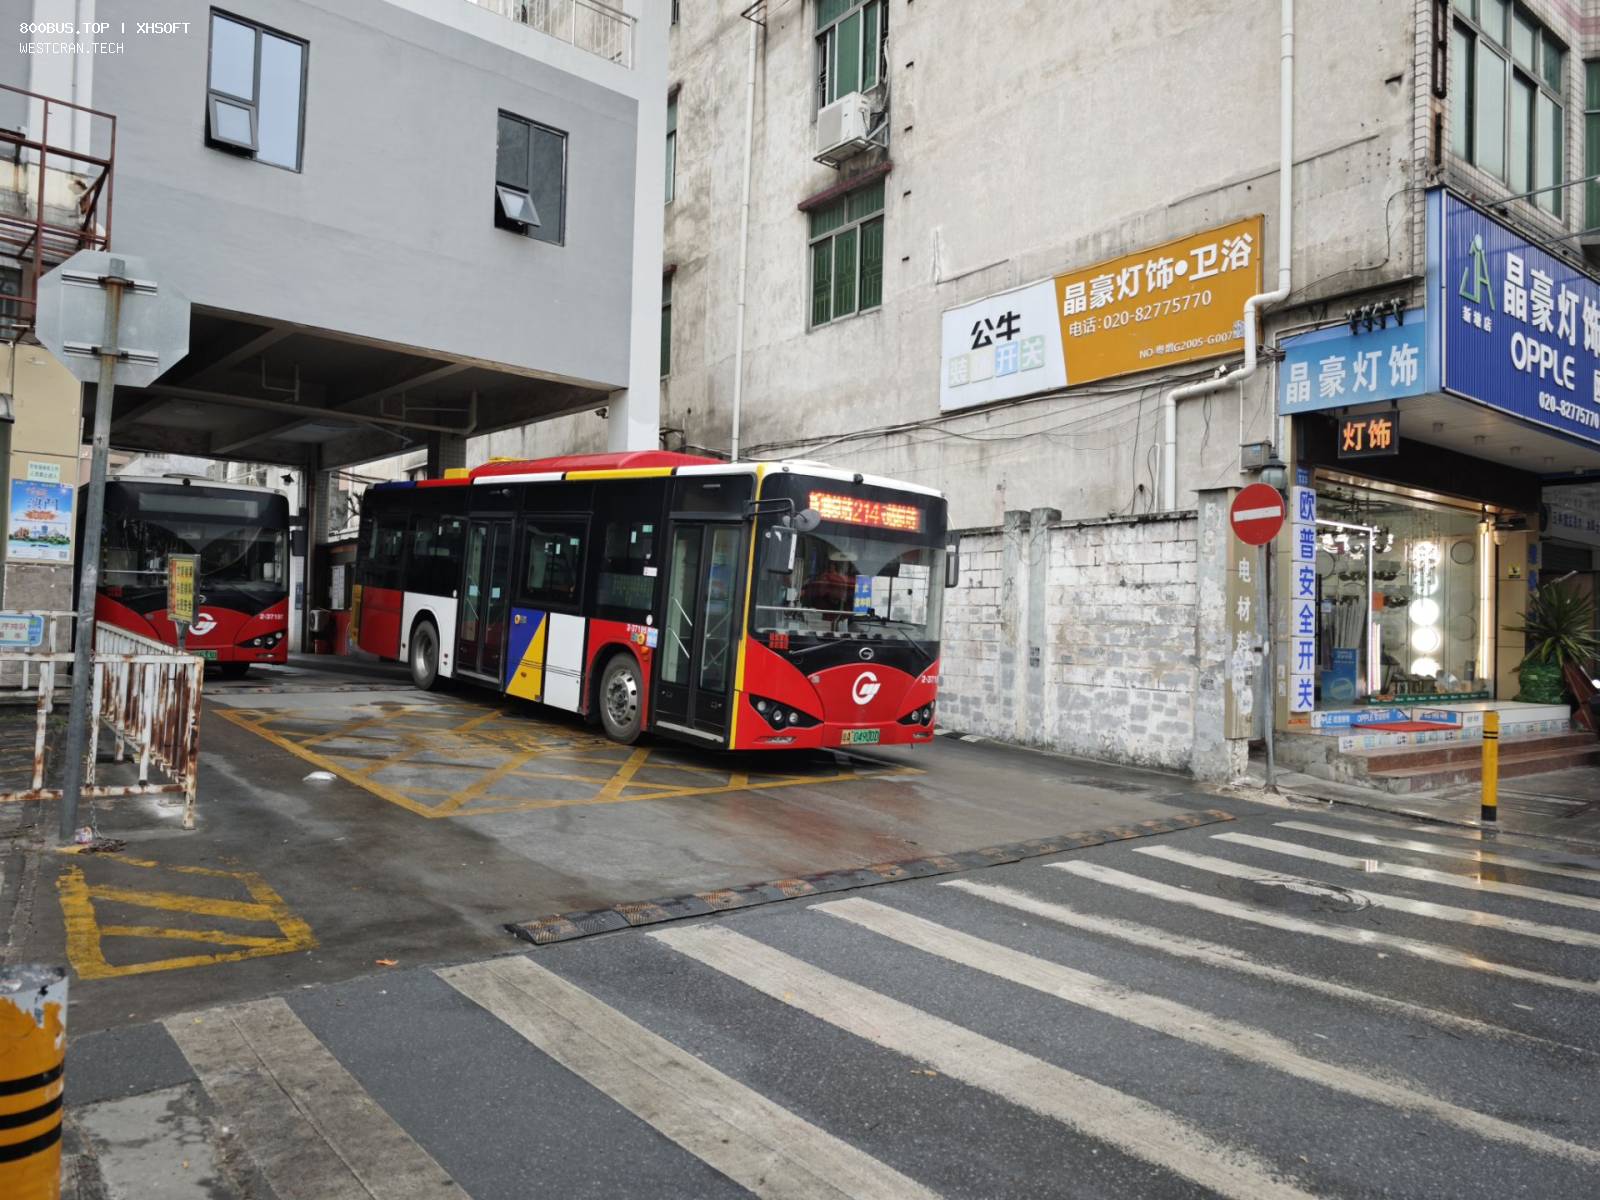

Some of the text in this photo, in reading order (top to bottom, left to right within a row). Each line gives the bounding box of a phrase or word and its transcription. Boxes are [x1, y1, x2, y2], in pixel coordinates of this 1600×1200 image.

[970, 310, 1021, 350] 公牛
[1286, 343, 1419, 405] 晶豪灯饰
[1511, 331, 1575, 391] OPPLE
[1539, 391, 1600, 430] 020-82775770
[1343, 419, 1392, 452] 灯饰
[852, 501, 880, 525] 214
[1298, 491, 1315, 709] 欧普安全开关
